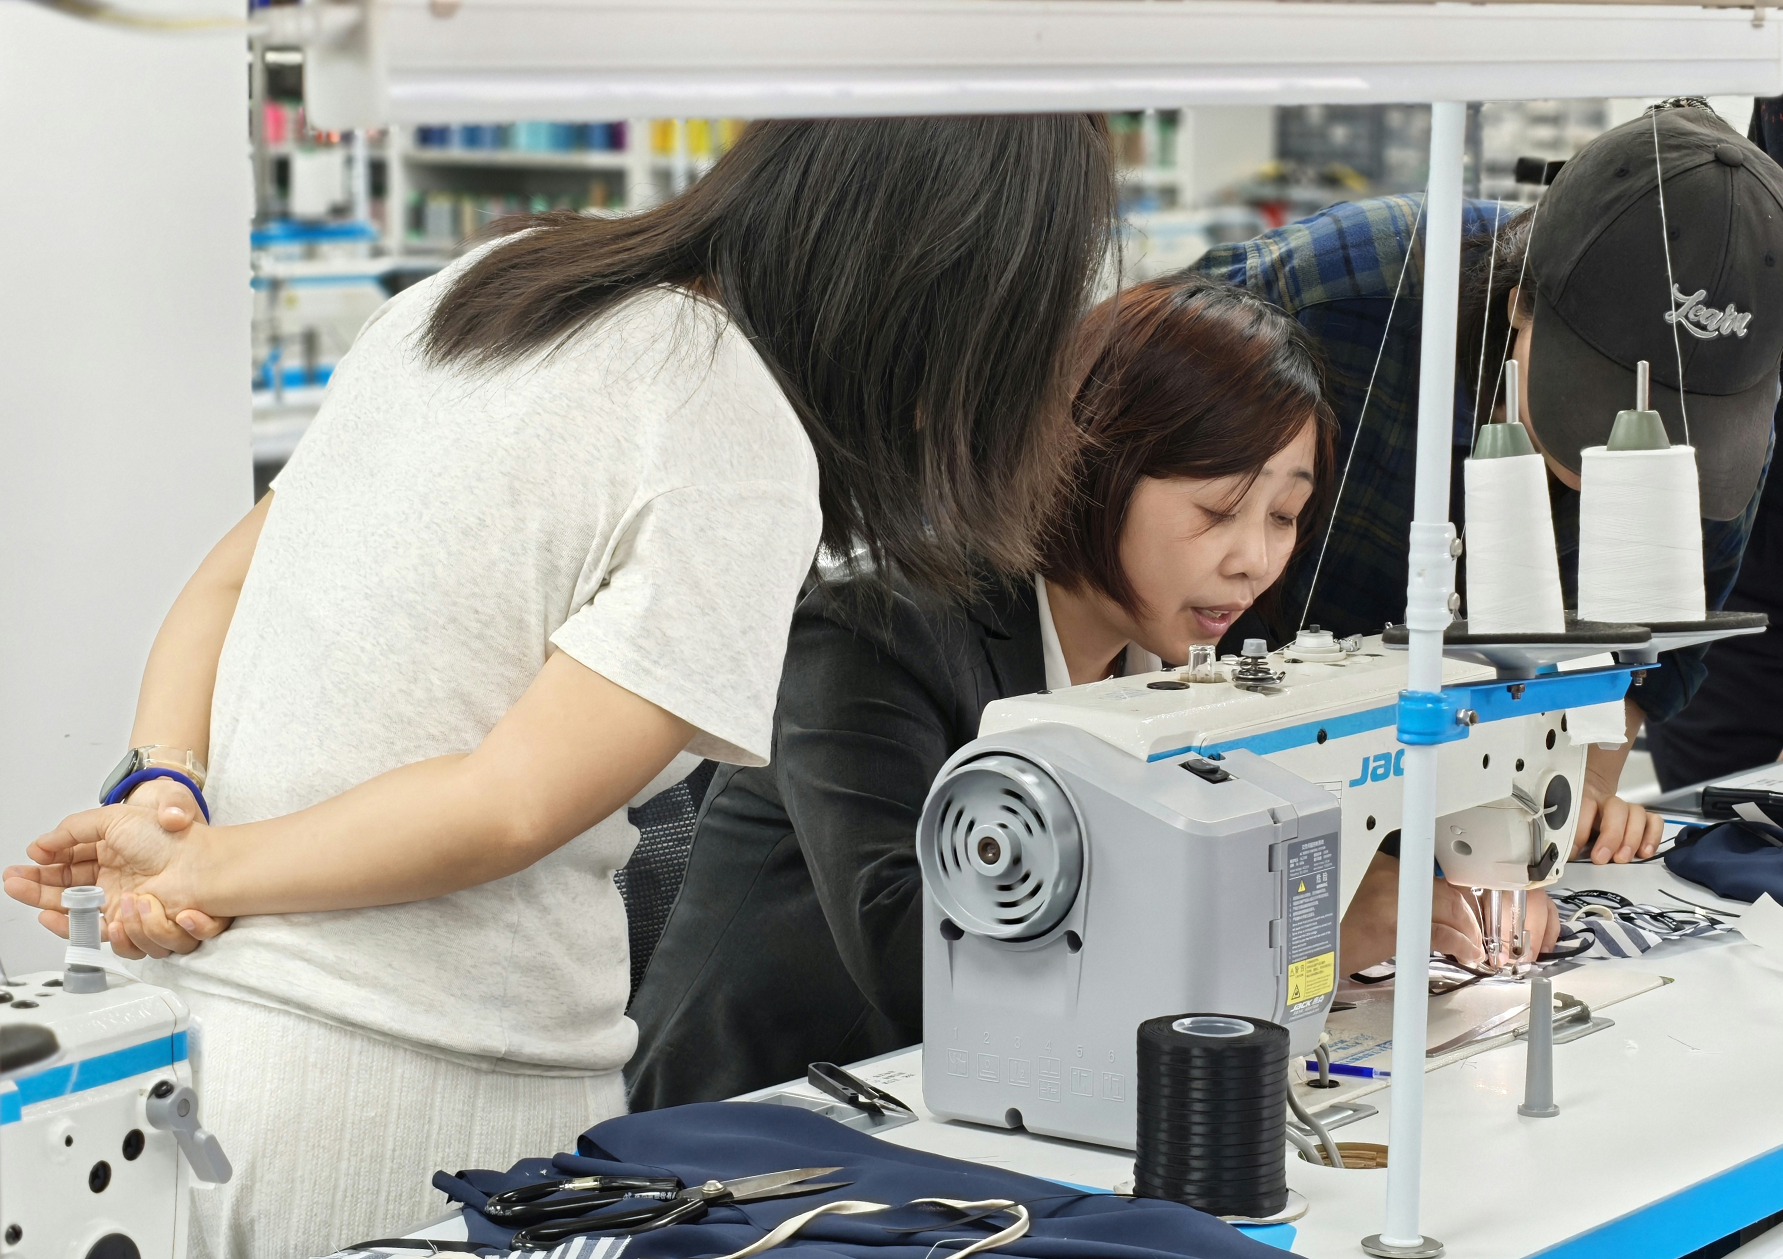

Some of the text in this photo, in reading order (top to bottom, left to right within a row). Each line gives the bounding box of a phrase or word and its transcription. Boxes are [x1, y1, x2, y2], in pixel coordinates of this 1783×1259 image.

[1664, 283, 1752, 338] Learn
[953, 1026, 1115, 1063] 1 2 3 4 5 6
